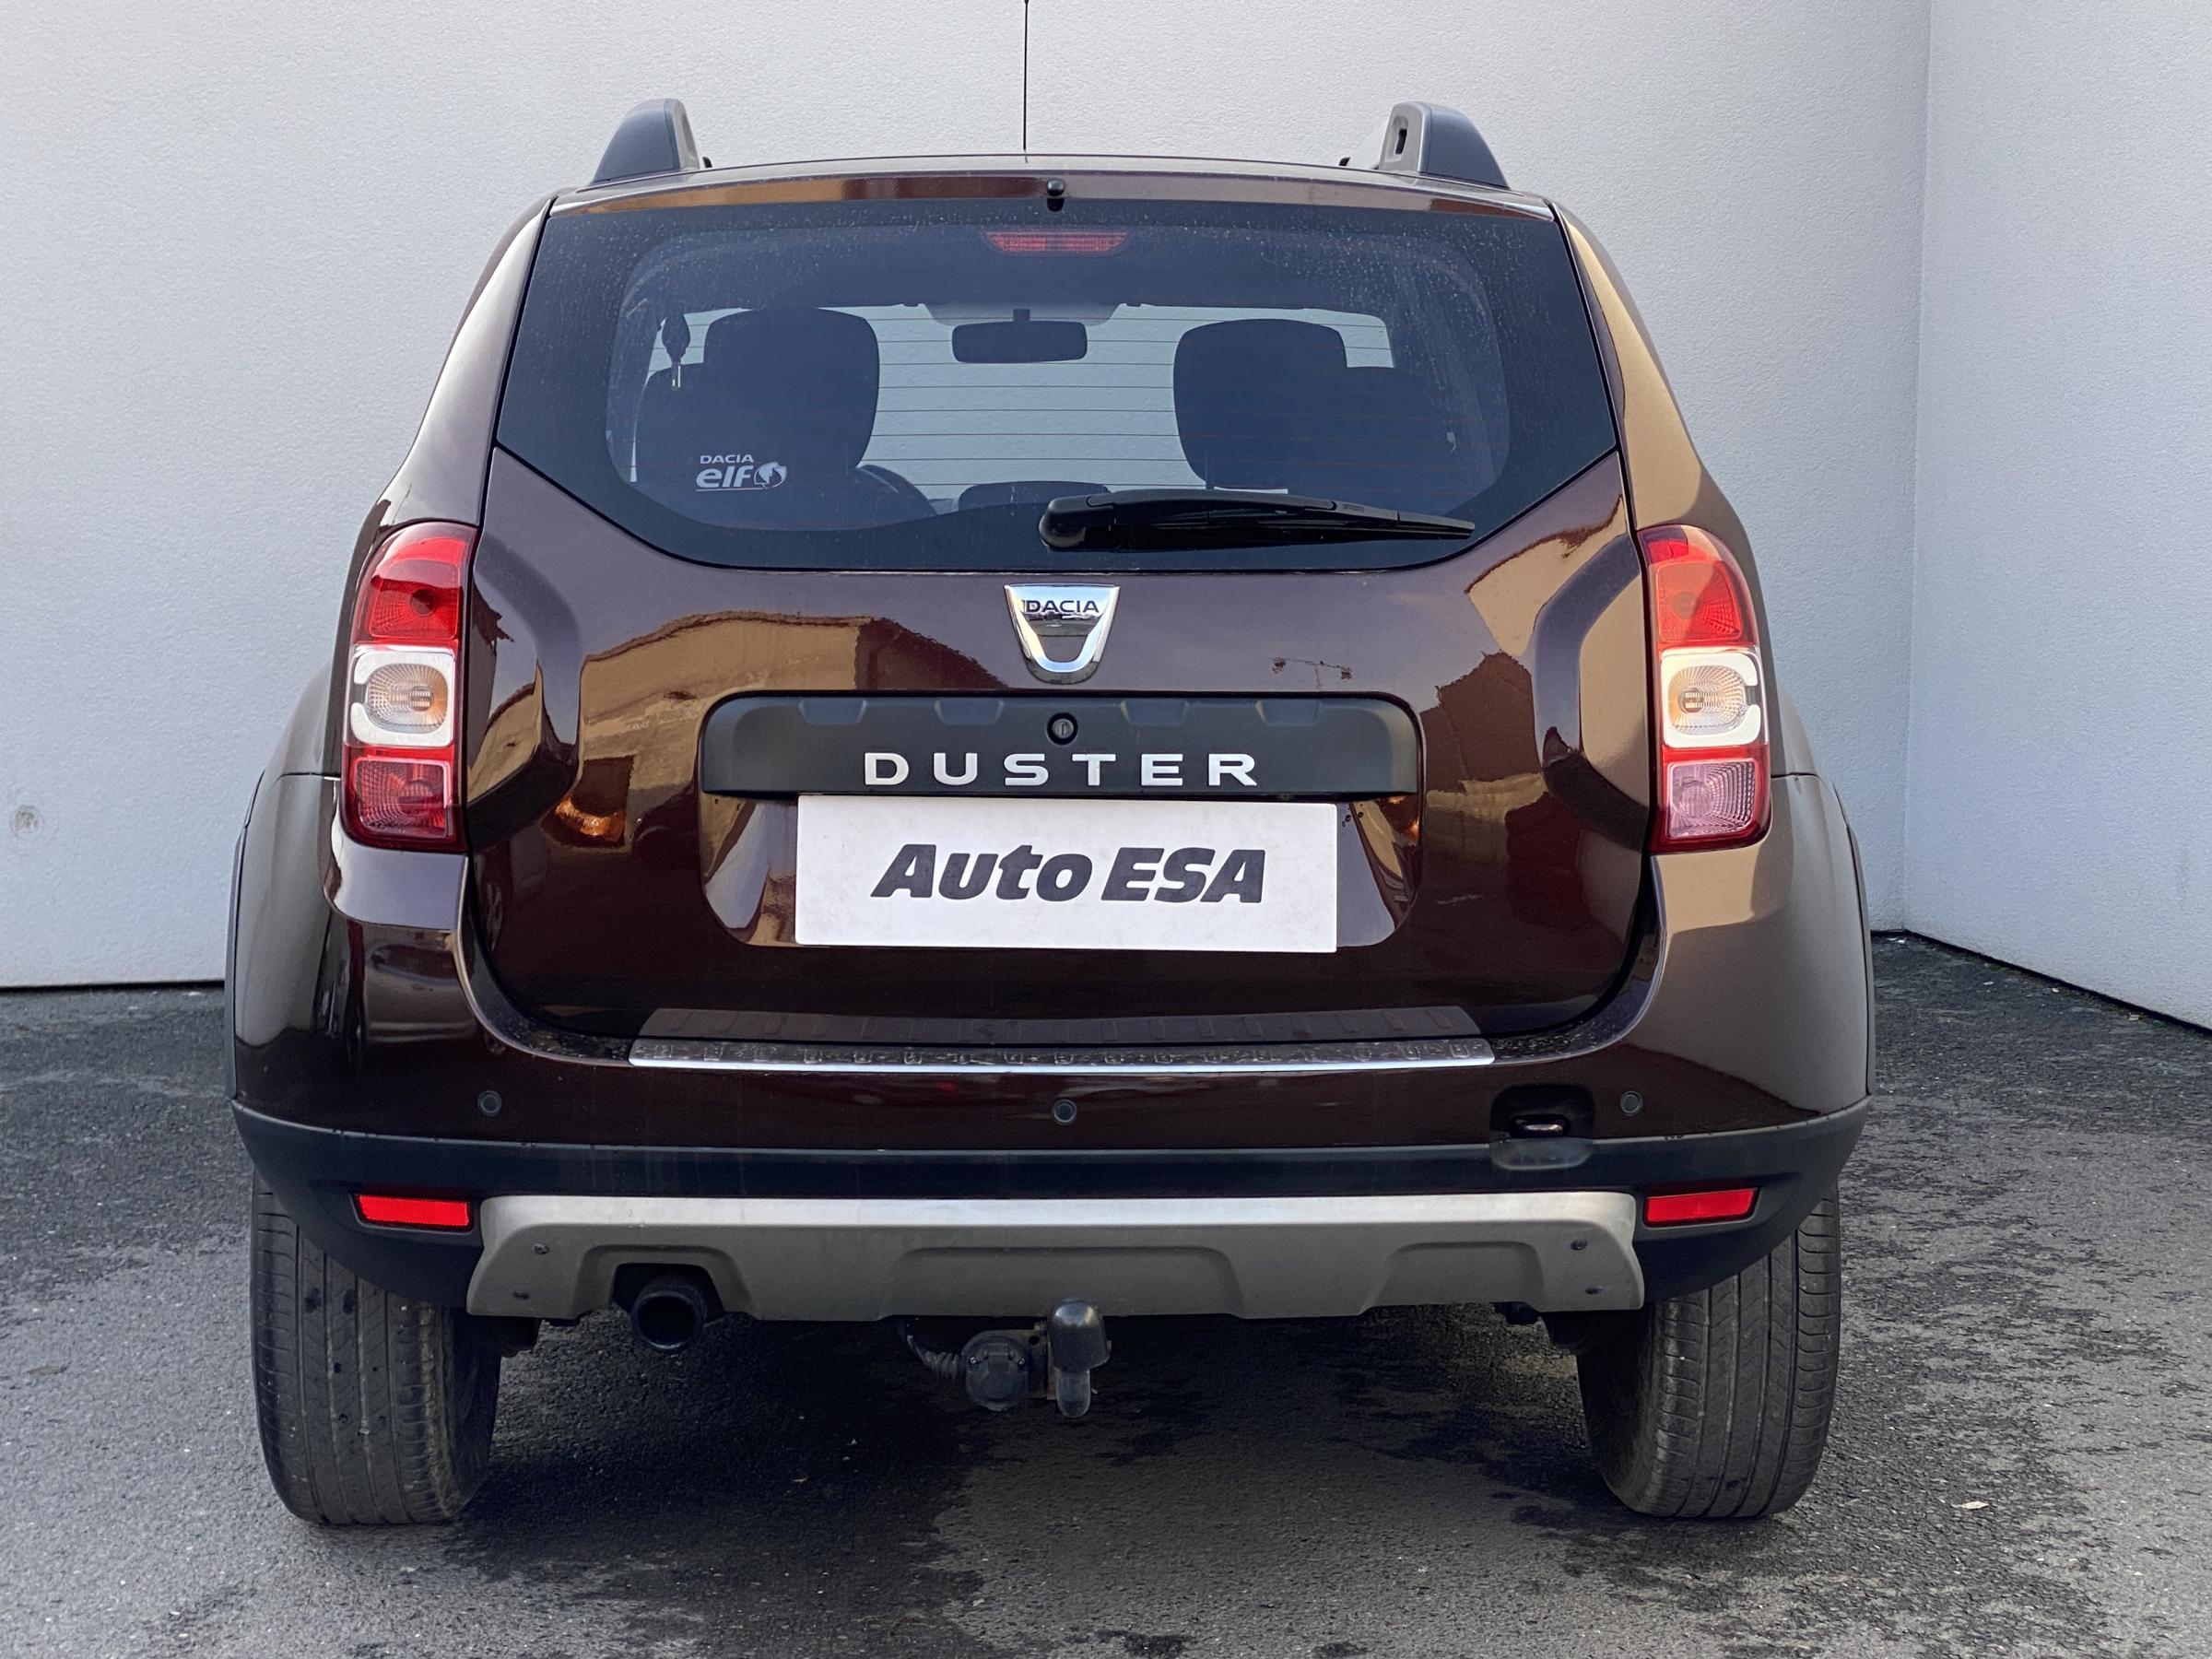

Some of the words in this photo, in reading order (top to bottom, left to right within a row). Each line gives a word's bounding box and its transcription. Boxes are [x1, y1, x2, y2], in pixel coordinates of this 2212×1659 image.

[700, 454, 754, 465] DACIA
[696, 465, 754, 488] elf
[1026, 600, 1100, 613] DACIA
[864, 752, 1258, 787] DUSTER
[870, 843, 1093, 902] Auto
[1101, 847, 1266, 904] ESA
